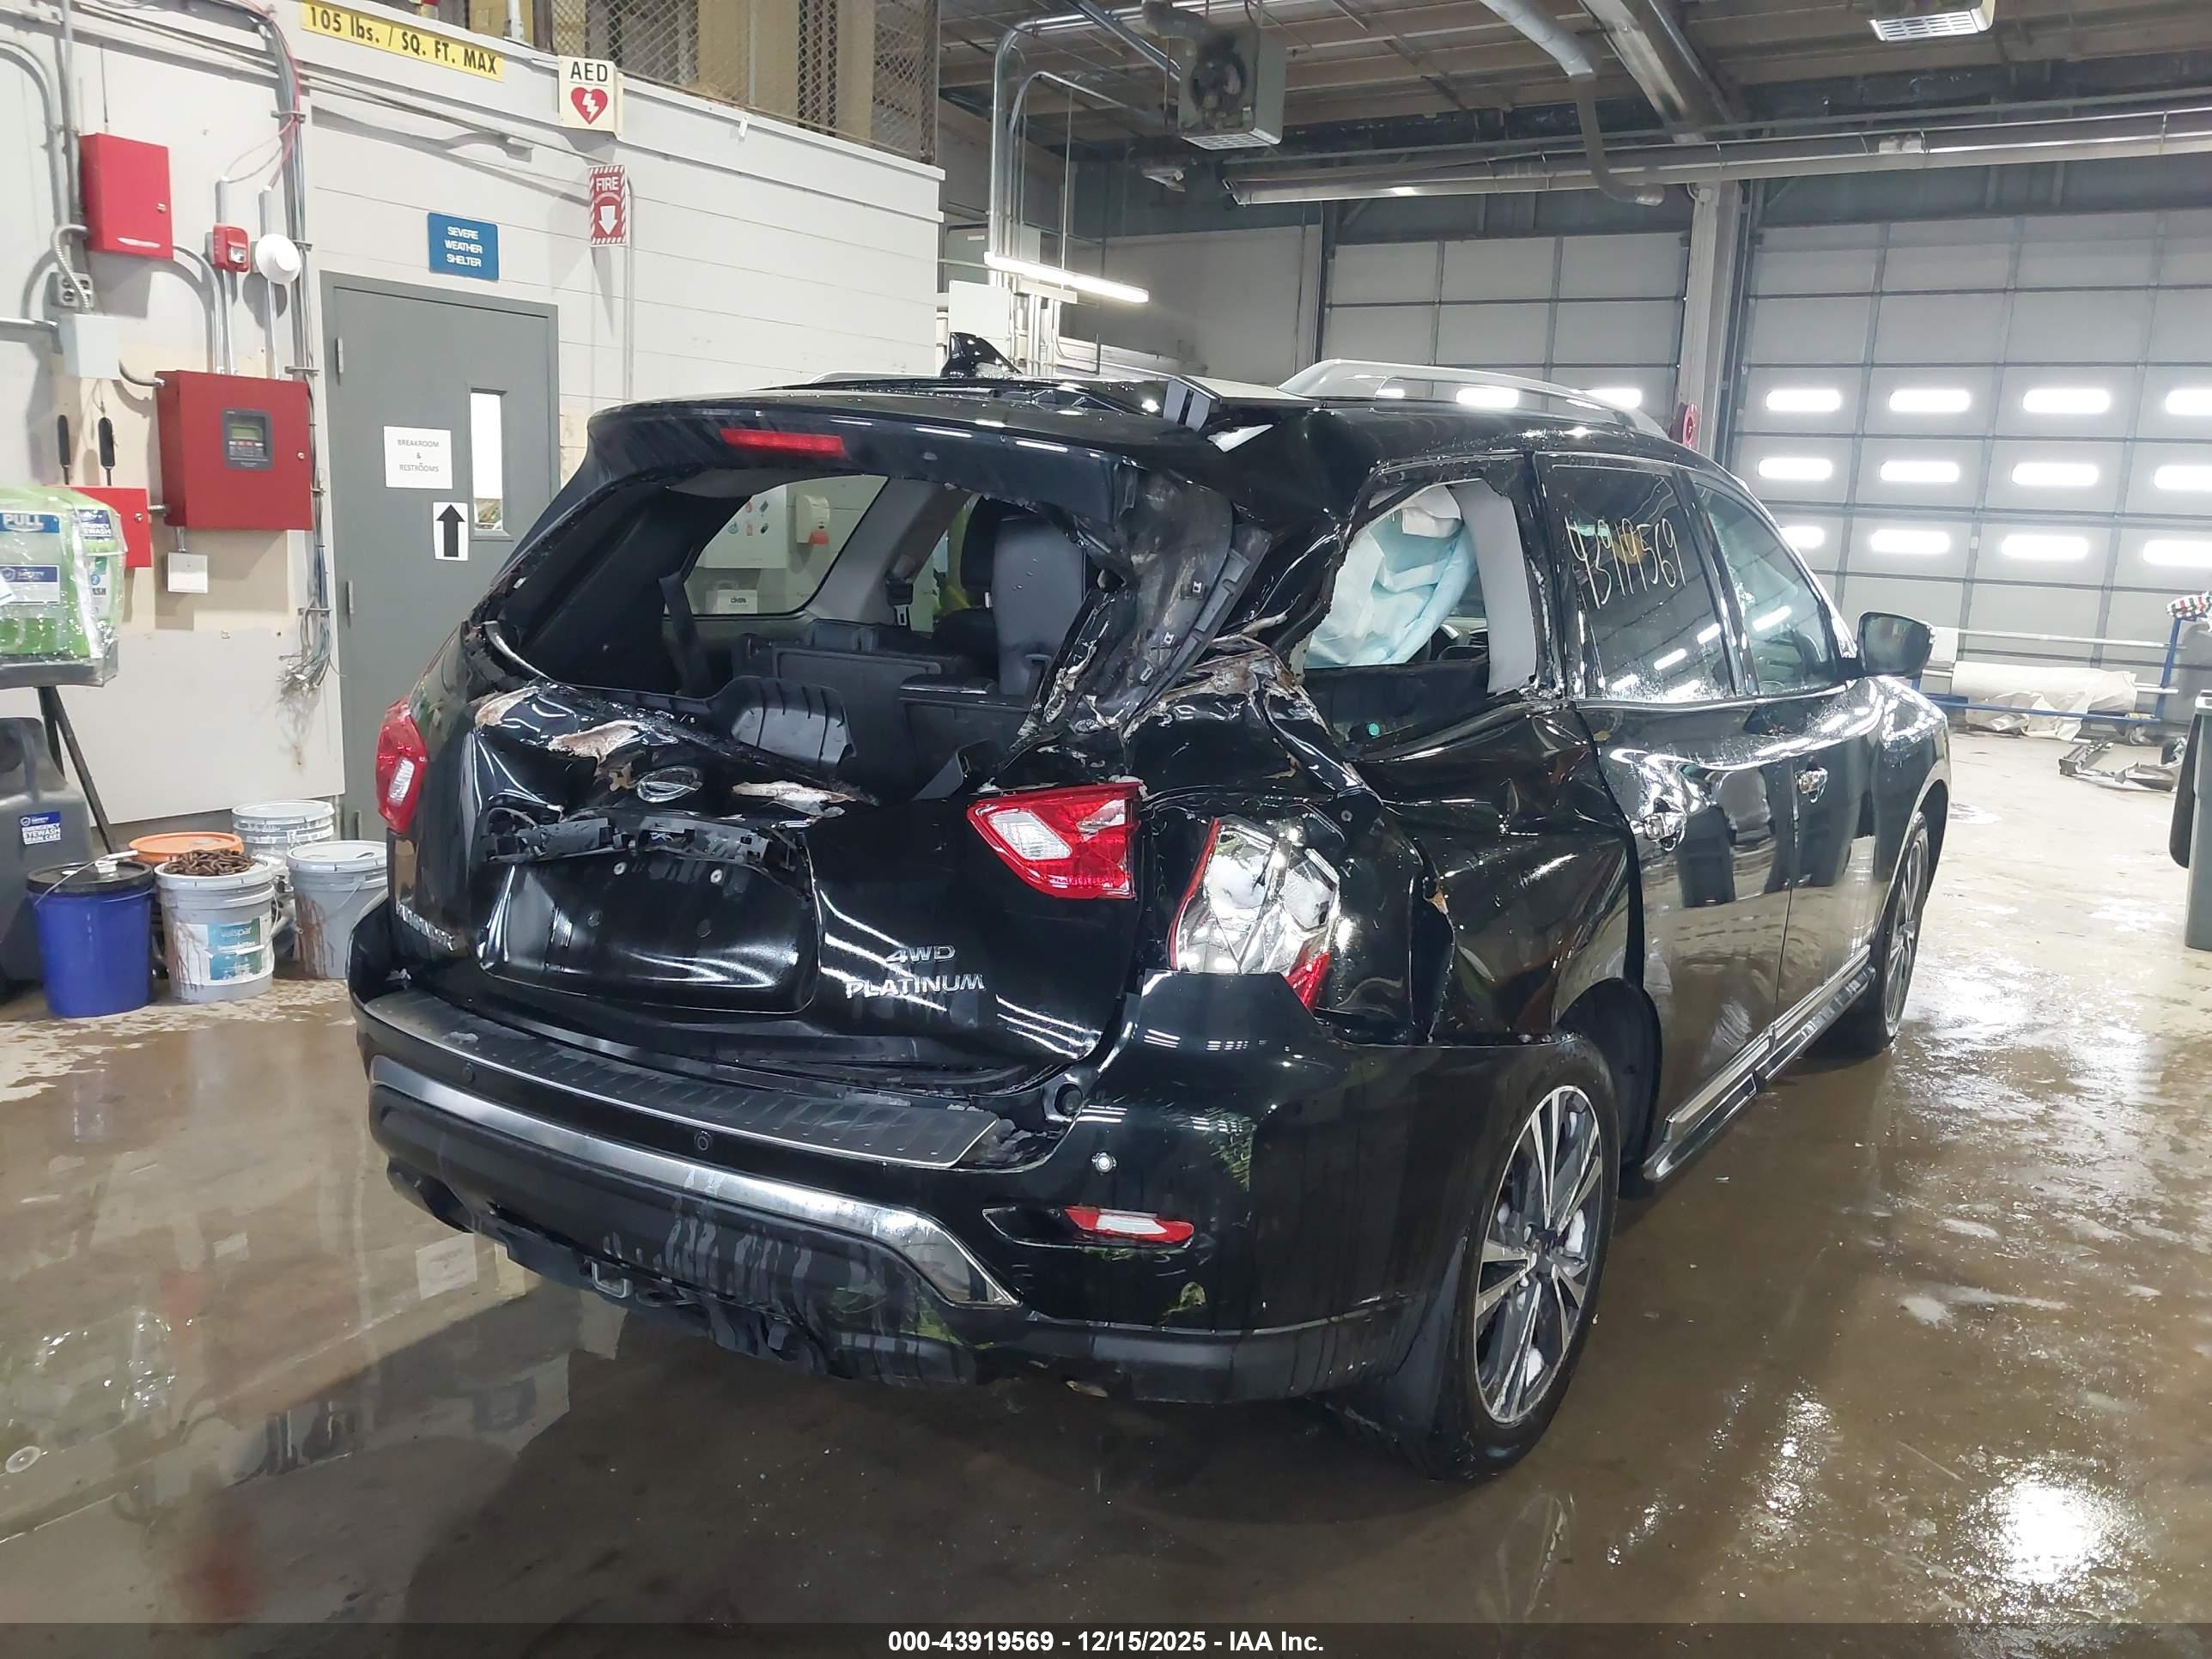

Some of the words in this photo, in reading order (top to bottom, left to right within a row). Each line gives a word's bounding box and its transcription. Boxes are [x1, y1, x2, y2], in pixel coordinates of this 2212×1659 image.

[310, 7, 342, 33] 105
[350, 15, 380, 44] lbs.
[388, 27, 393, 46] /
[401, 32, 427, 56] SQ.
[434, 40, 456, 64] FT.
[463, 48, 497, 75] MAX
[570, 61, 608, 82] AED
[596, 176, 619, 191] FIRE
[447, 226, 479, 240] SEVERE
[444, 240, 483, 254] WEATHER
[447, 253, 481, 268] SHELTER
[398, 439, 439, 447] BREAKROOM
[399, 464, 439, 472] RESTROOMS
[3, 514, 44, 526] PULL
[885, 945, 956, 963] 4WD
[844, 974, 986, 1000] PLATINUM
